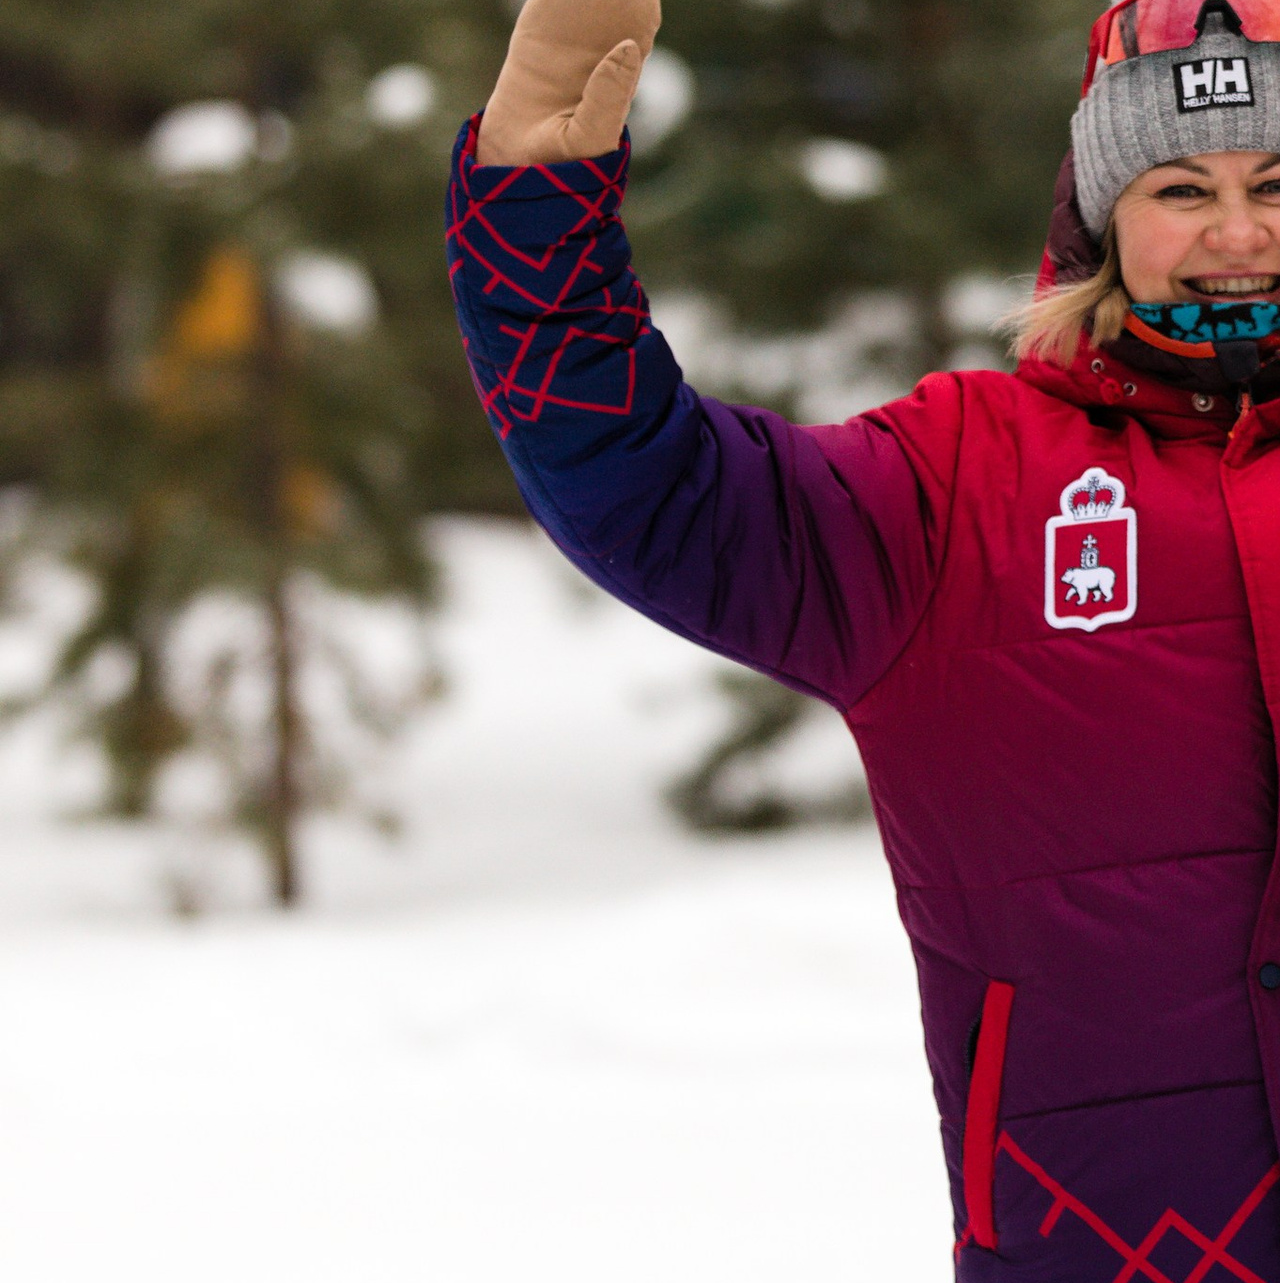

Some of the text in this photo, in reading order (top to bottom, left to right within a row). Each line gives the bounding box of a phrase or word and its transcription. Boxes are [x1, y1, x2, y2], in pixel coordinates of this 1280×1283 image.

[1180, 59, 1249, 98] HH
[1183, 93, 1250, 109] HELLY HANSEN
